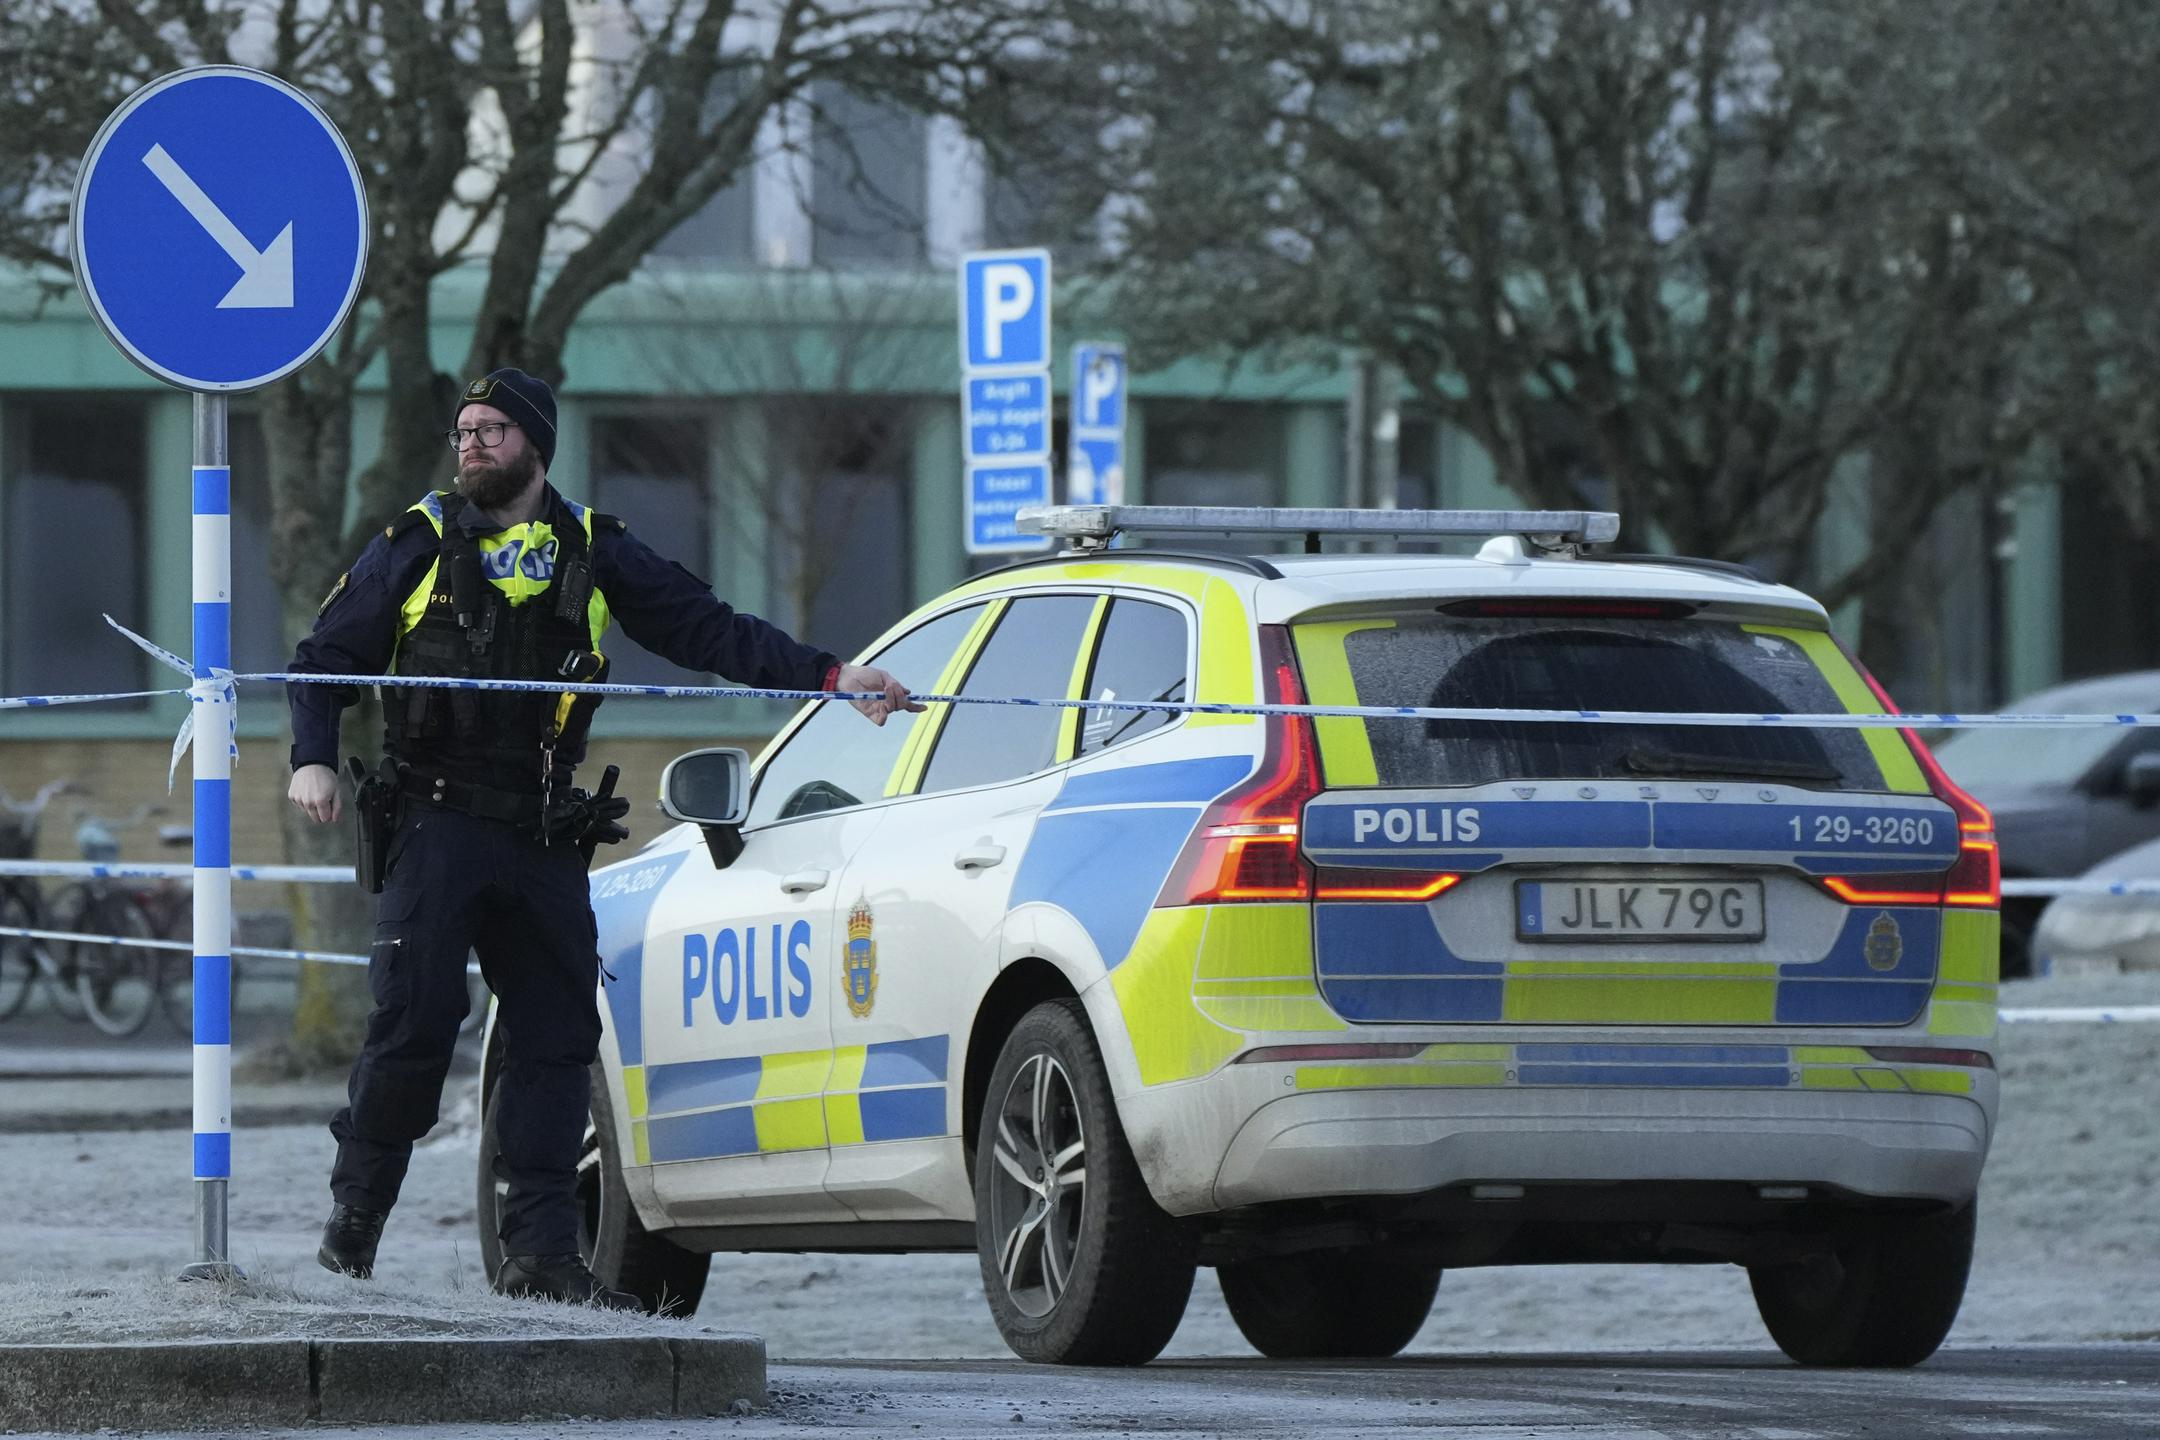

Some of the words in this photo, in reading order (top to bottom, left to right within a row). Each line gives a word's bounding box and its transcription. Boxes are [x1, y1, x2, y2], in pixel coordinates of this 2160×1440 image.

[983, 263, 1035, 359] P
[1083, 356, 1118, 423] P
[1512, 786, 1778, 802] VOLVO
[1353, 807, 1481, 843] POLIS
[1788, 815, 1801, 842] 1
[1814, 815, 1934, 845] 29-3260
[1527, 914, 1536, 926] S
[1560, 887, 1643, 929] JLK
[1657, 887, 1744, 929] 79G
[683, 919, 812, 1028] POLIS
